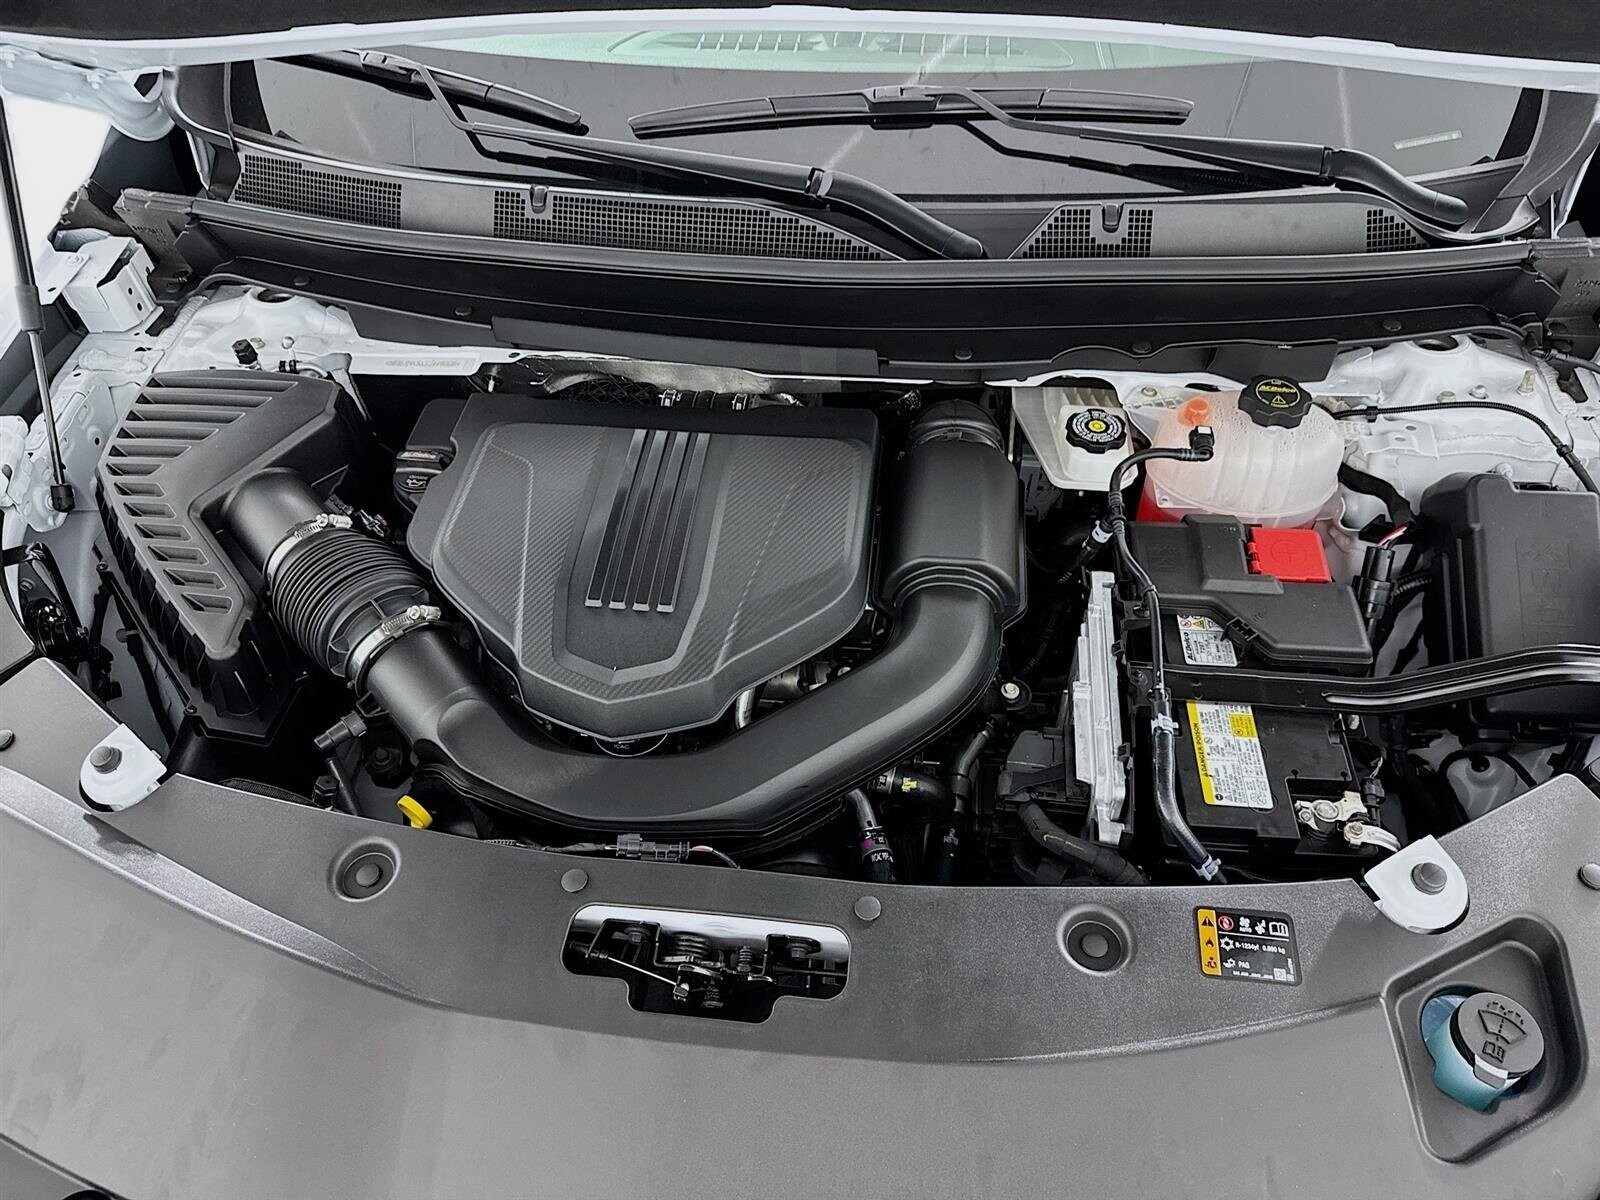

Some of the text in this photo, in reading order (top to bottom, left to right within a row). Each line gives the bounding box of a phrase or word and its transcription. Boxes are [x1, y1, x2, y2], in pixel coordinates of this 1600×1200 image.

[1183, 632, 1193, 661] ACDelco
[1193, 723, 1208, 773] DANGER POISON
